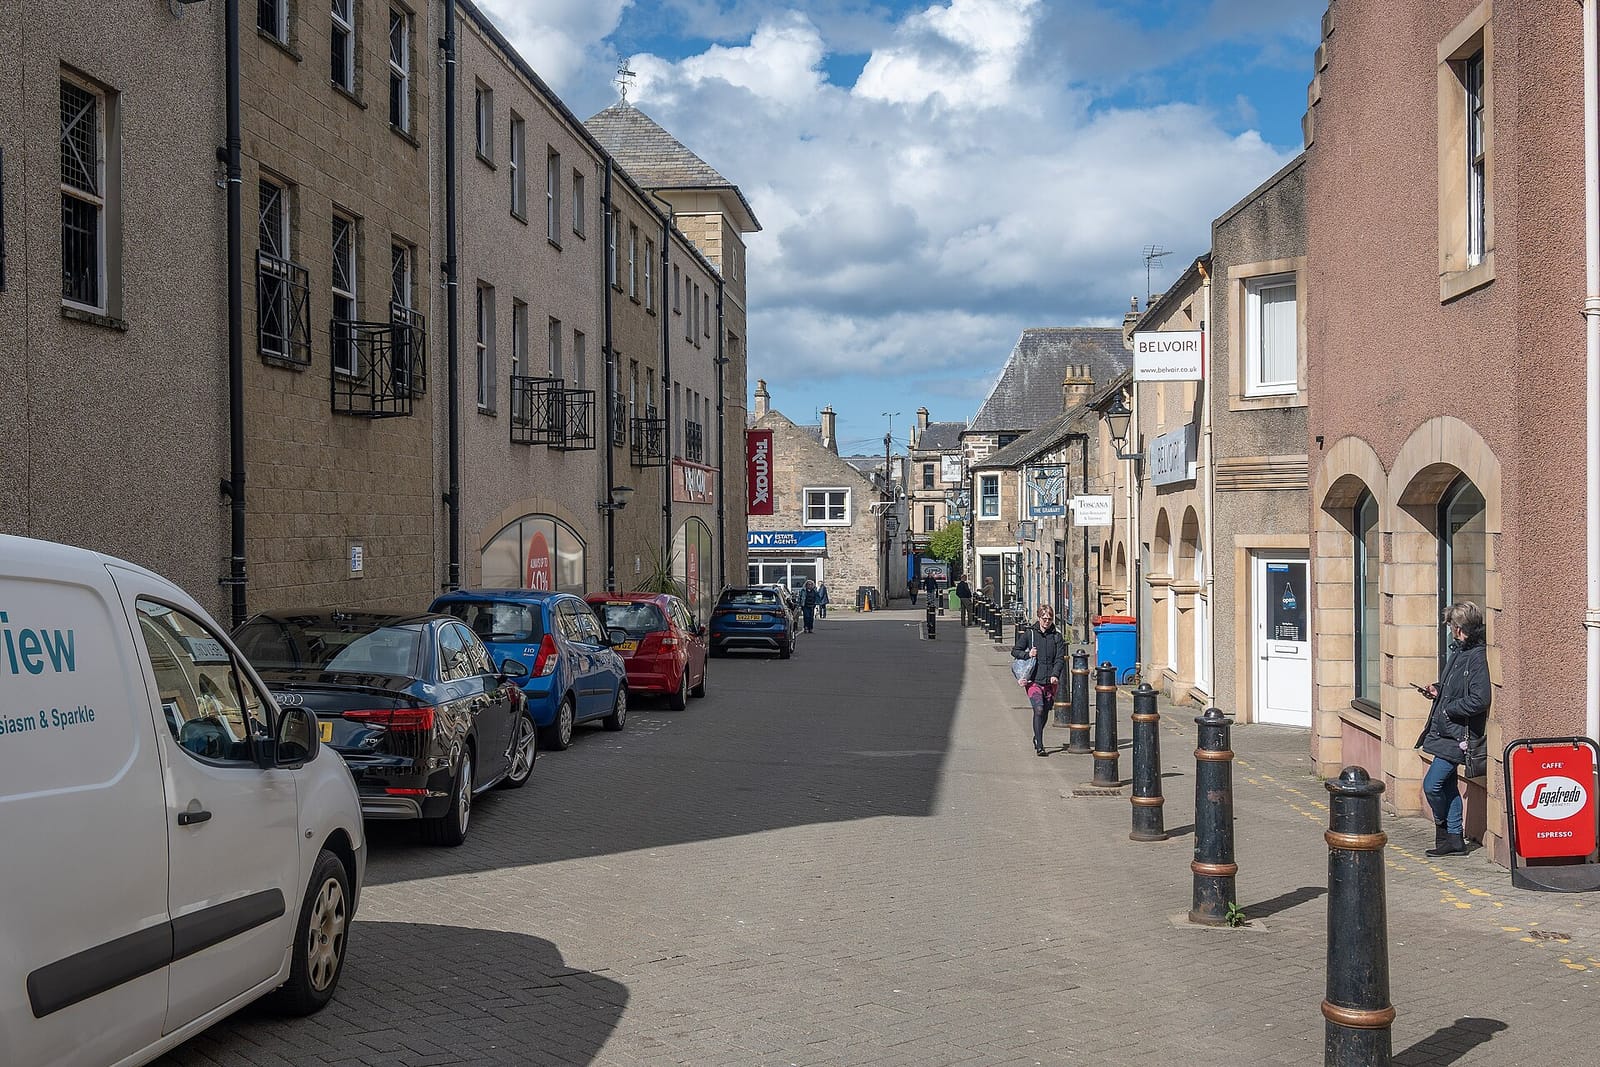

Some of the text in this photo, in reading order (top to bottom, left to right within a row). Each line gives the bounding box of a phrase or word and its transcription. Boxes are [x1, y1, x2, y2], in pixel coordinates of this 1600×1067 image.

[1139, 340, 1198, 353] BELVOIR!
[0, 611, 75, 675] iew
[39, 710, 49, 729] &
[51, 704, 95, 730] Sparkle
[1527, 783, 1581, 810] Segafredo
[1536, 831, 1573, 839] ESPRESSO
